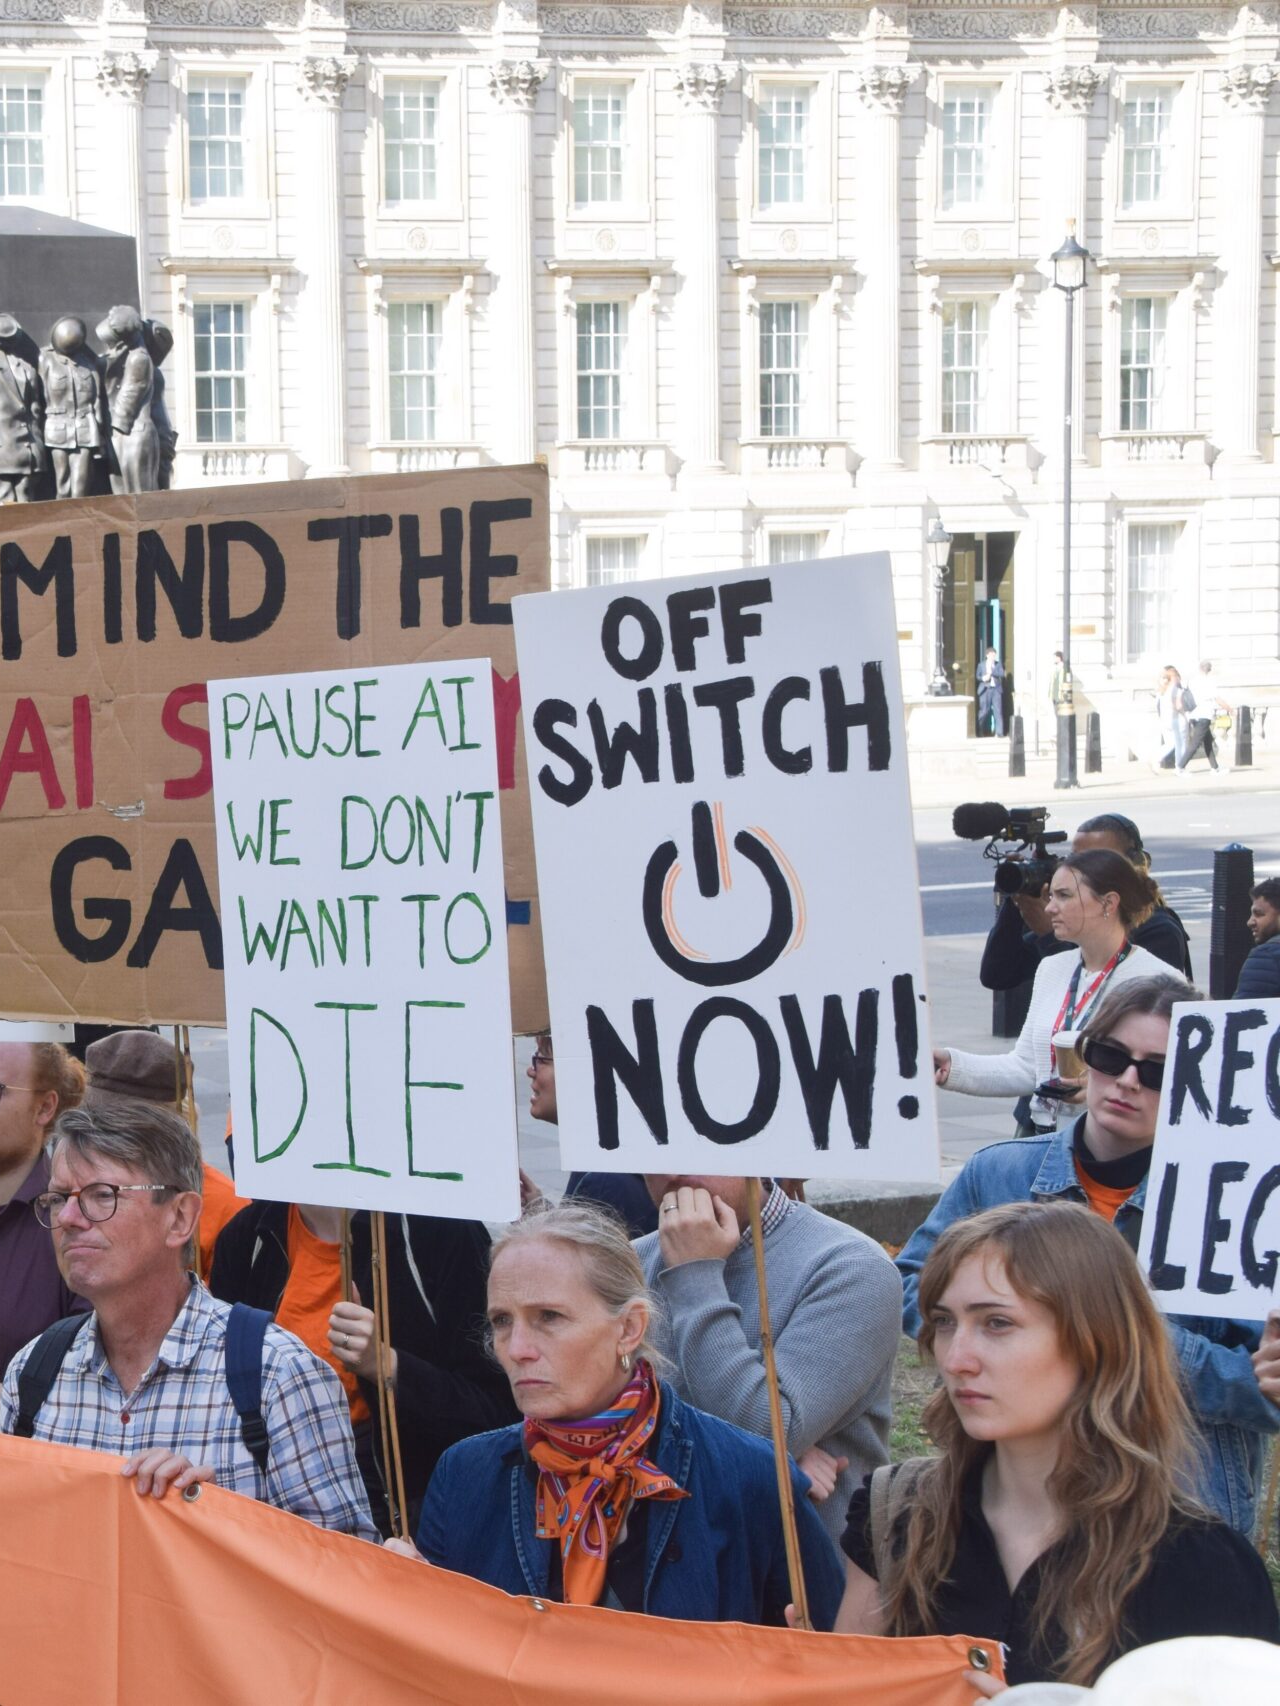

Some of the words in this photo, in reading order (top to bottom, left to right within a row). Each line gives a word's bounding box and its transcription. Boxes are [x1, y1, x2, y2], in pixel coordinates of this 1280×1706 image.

[0, 520, 286, 661] MIND
[307, 498, 533, 641] THE
[601, 577, 774, 682] OFF
[222, 678, 381, 760] PAUSE
[401, 676, 482, 752] AI
[532, 661, 892, 807] SWITCH
[226, 798, 301, 866] WE
[340, 789, 495, 874] DON'T
[238, 894, 380, 972] WANT
[400, 891, 492, 969] TO
[249, 1000, 466, 1182] DIE
[586, 973, 920, 1151] NOW!
